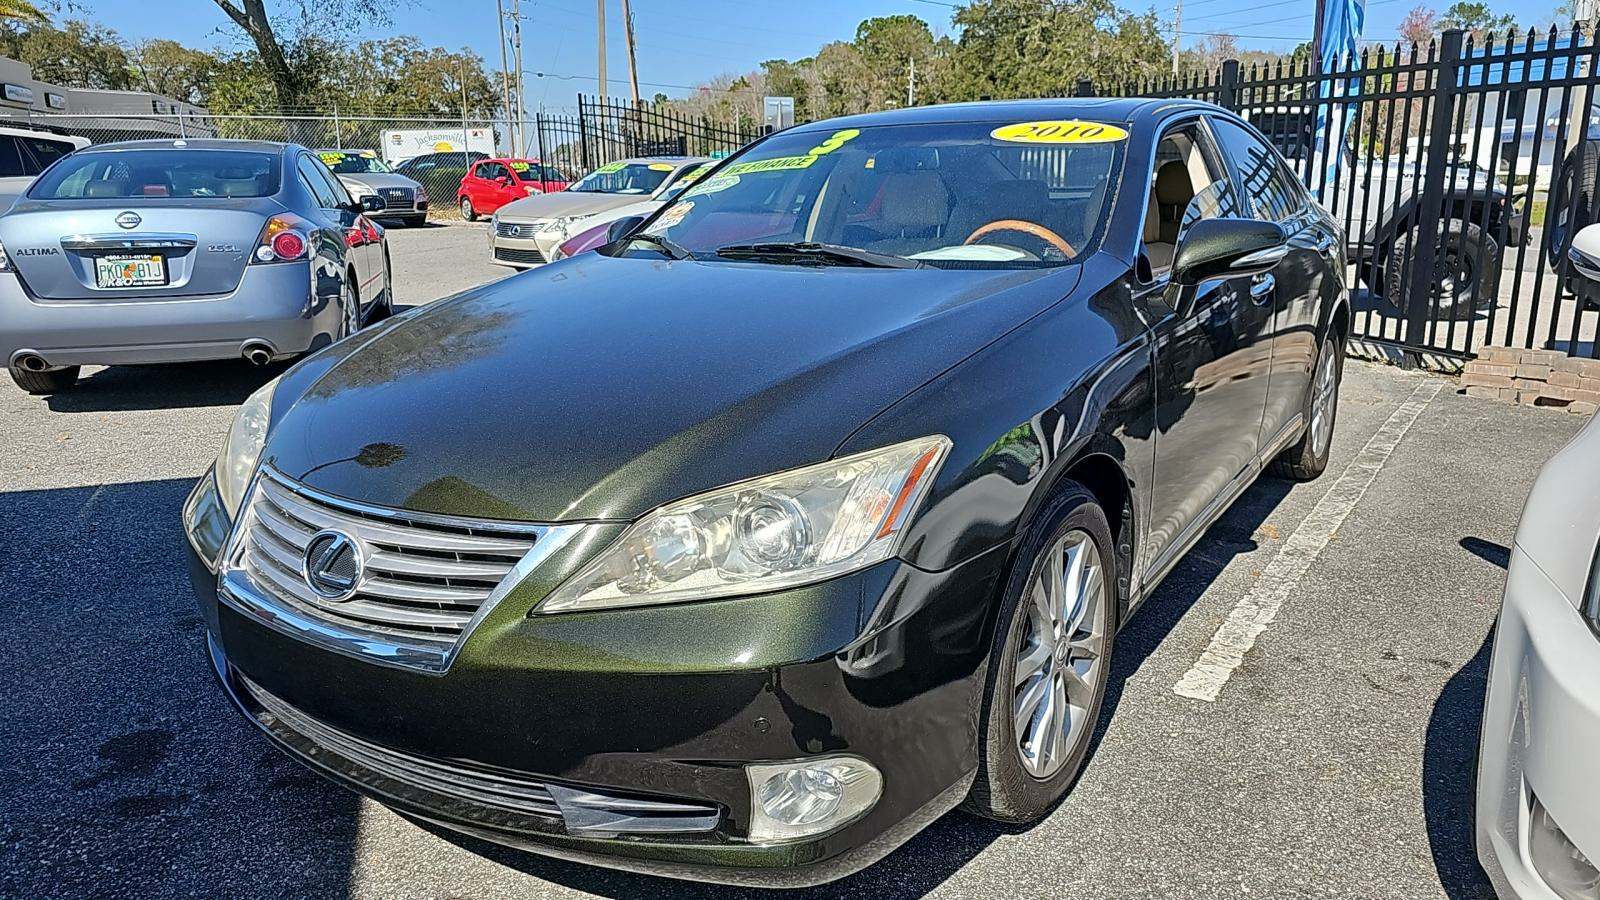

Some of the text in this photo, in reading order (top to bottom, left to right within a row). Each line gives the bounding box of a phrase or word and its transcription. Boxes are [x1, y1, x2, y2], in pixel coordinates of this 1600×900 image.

[1013, 125, 1105, 138] 2010
[808, 128, 860, 156] 3
[16, 247, 60, 256] ALTIMA
[138, 262, 162, 278] B1J
